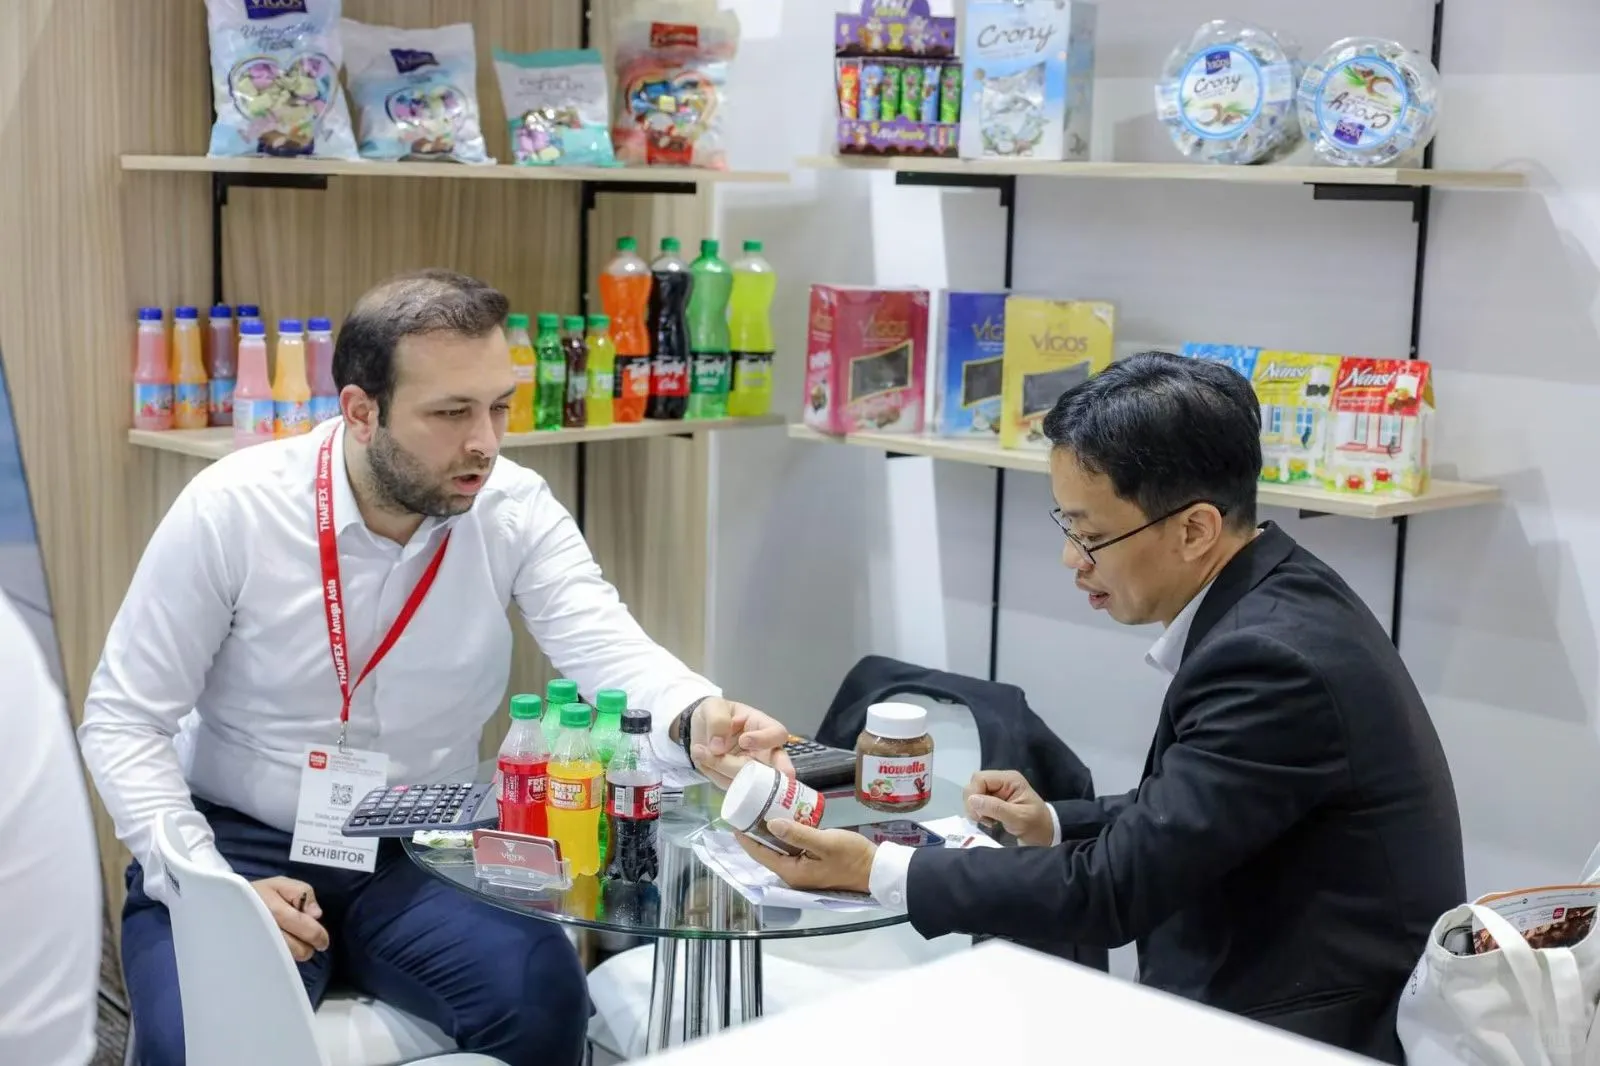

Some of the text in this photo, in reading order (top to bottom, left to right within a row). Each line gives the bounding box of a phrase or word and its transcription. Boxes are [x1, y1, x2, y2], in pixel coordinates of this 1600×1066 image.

[977, 24, 1056, 53] Crony
[1193, 75, 1242, 92] Crony
[857, 313, 908, 337] VIGOS
[1029, 327, 1089, 353] VIGOS
[318, 488, 330, 531] THAIFEX
[326, 579, 337, 600] Asia
[331, 602, 342, 634] Anuga
[332, 643, 347, 684] THAIFEX
[879, 761, 925, 774] nowella
[302, 845, 365, 864] EXHIBITOR
